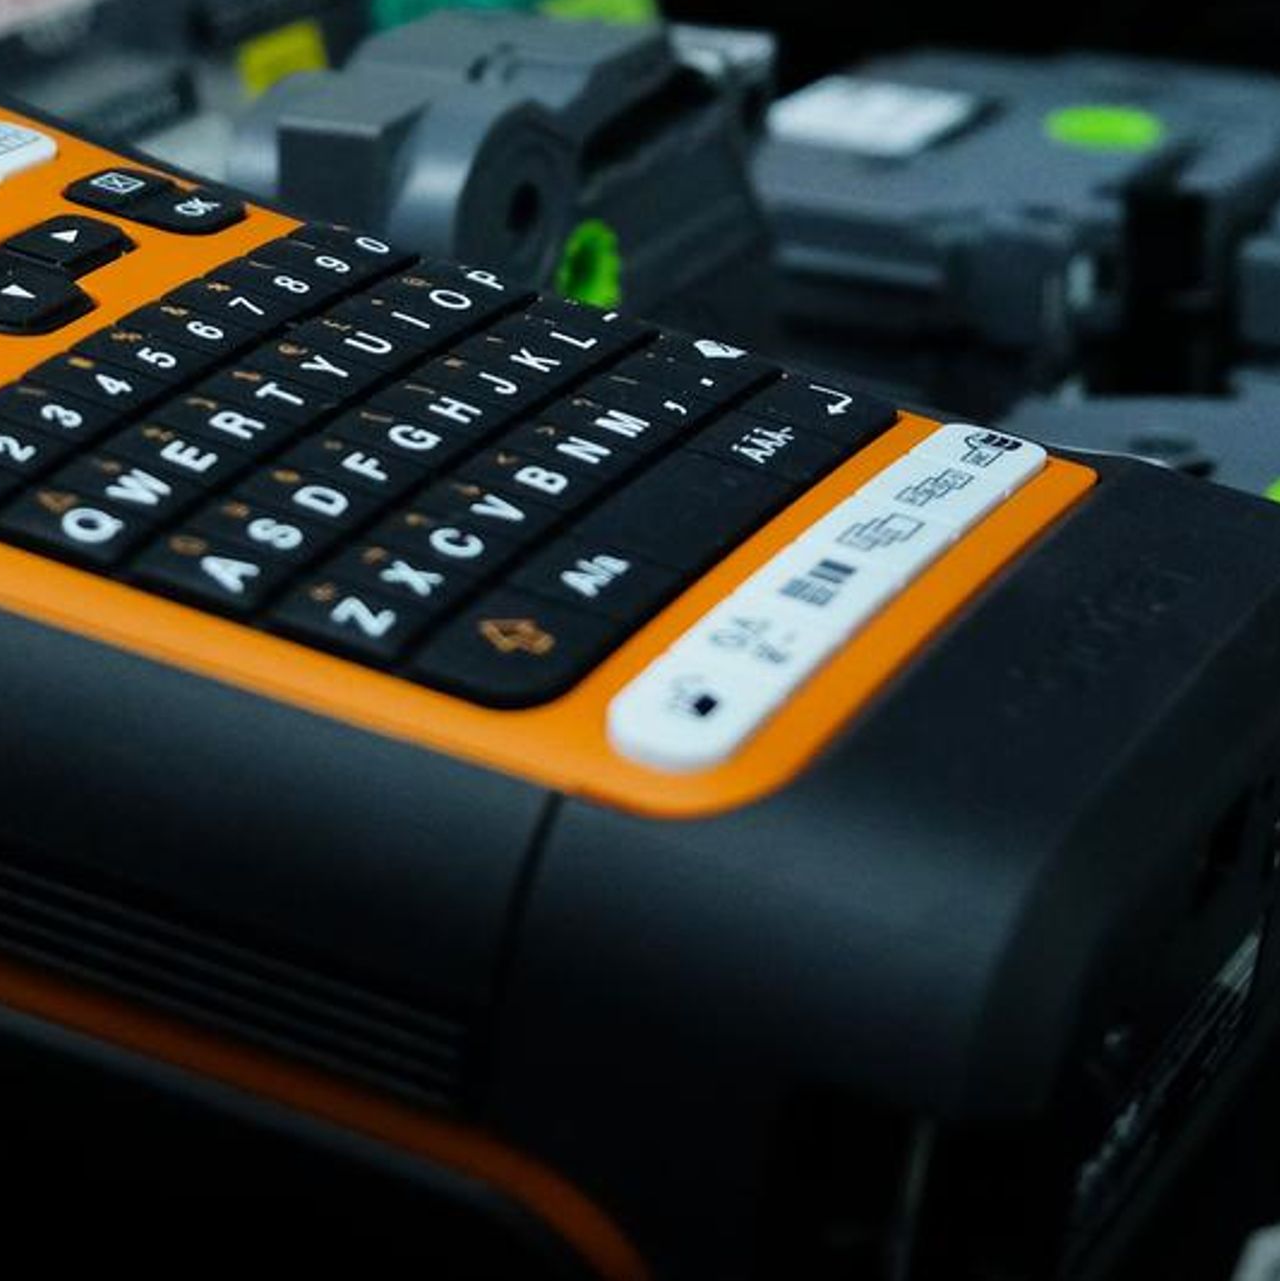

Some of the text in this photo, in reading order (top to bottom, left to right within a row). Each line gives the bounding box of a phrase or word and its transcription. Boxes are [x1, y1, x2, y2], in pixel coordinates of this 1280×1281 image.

[40, 403, 84, 429] 3
[94, 372, 134, 396] 4
[135, 346, 178, 369] 5
[185, 319, 225, 341] 6
[227, 295, 266, 317] 7
[272, 274, 311, 295] 8
[313, 254, 352, 274] 9
[354, 235, 391, 255] 0
[62, 269, 505, 543] Q W E R T Y U I O P
[200, 555, 261, 594] A
[247, 517, 304, 550] S
[292, 484, 349, 518] D
[341, 451, 388, 482] F
[387, 423, 443, 451] G
[427, 395, 483, 425] H
[478, 371, 519, 396] J
[508, 347, 562, 374] K
[548, 330, 599, 350] L
[330, 596, 397, 637] Z
[379, 559, 445, 596] X
[428, 527, 486, 559] C
[470, 493, 526, 522] V
[513, 465, 569, 495] B
[555, 435, 612, 465] N
[593, 408, 651, 439] M
